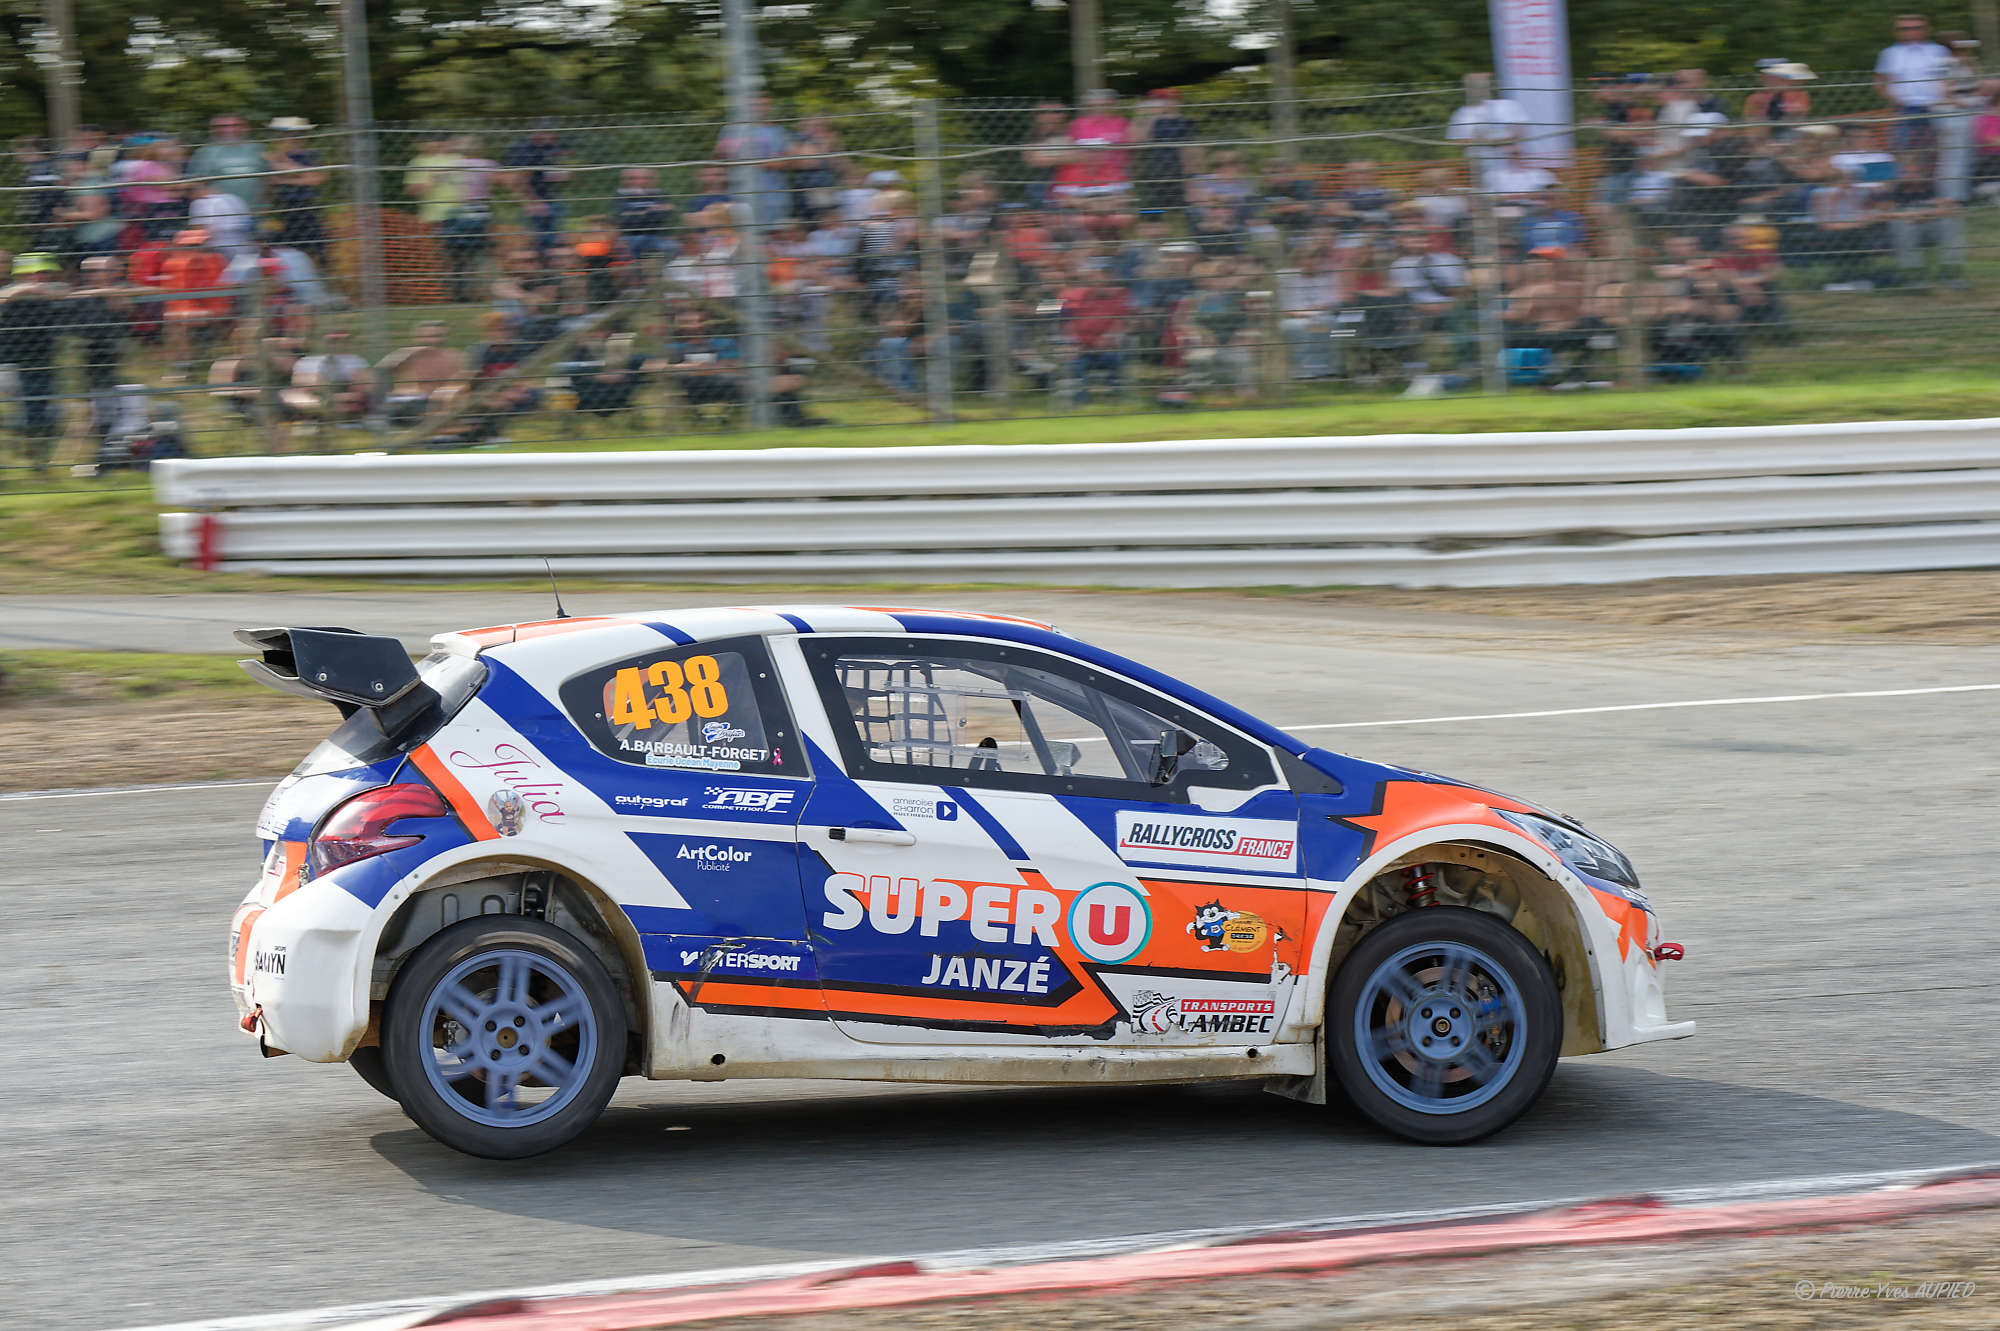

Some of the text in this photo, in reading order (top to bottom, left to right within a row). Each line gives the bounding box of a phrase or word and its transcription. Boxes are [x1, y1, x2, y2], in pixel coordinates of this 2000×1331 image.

[613, 655, 729, 730] 438
[619, 739, 768, 761] A.BARBAULT-FORGET
[450, 744, 567, 825] Julia
[615, 795, 688, 808] autograf
[705, 789, 795, 812] ABF
[1128, 822, 1292, 859] RALLYCROSS FRANCE
[675, 844, 752, 862] ArtColor
[697, 860, 730, 872] Publicité
[823, 873, 1131, 947] SUPER U
[921, 954, 1051, 993] JANZÉ
[1183, 1001, 1273, 1012] TRANSPORTS
[1179, 1014, 1274, 1033] LAMBEC
